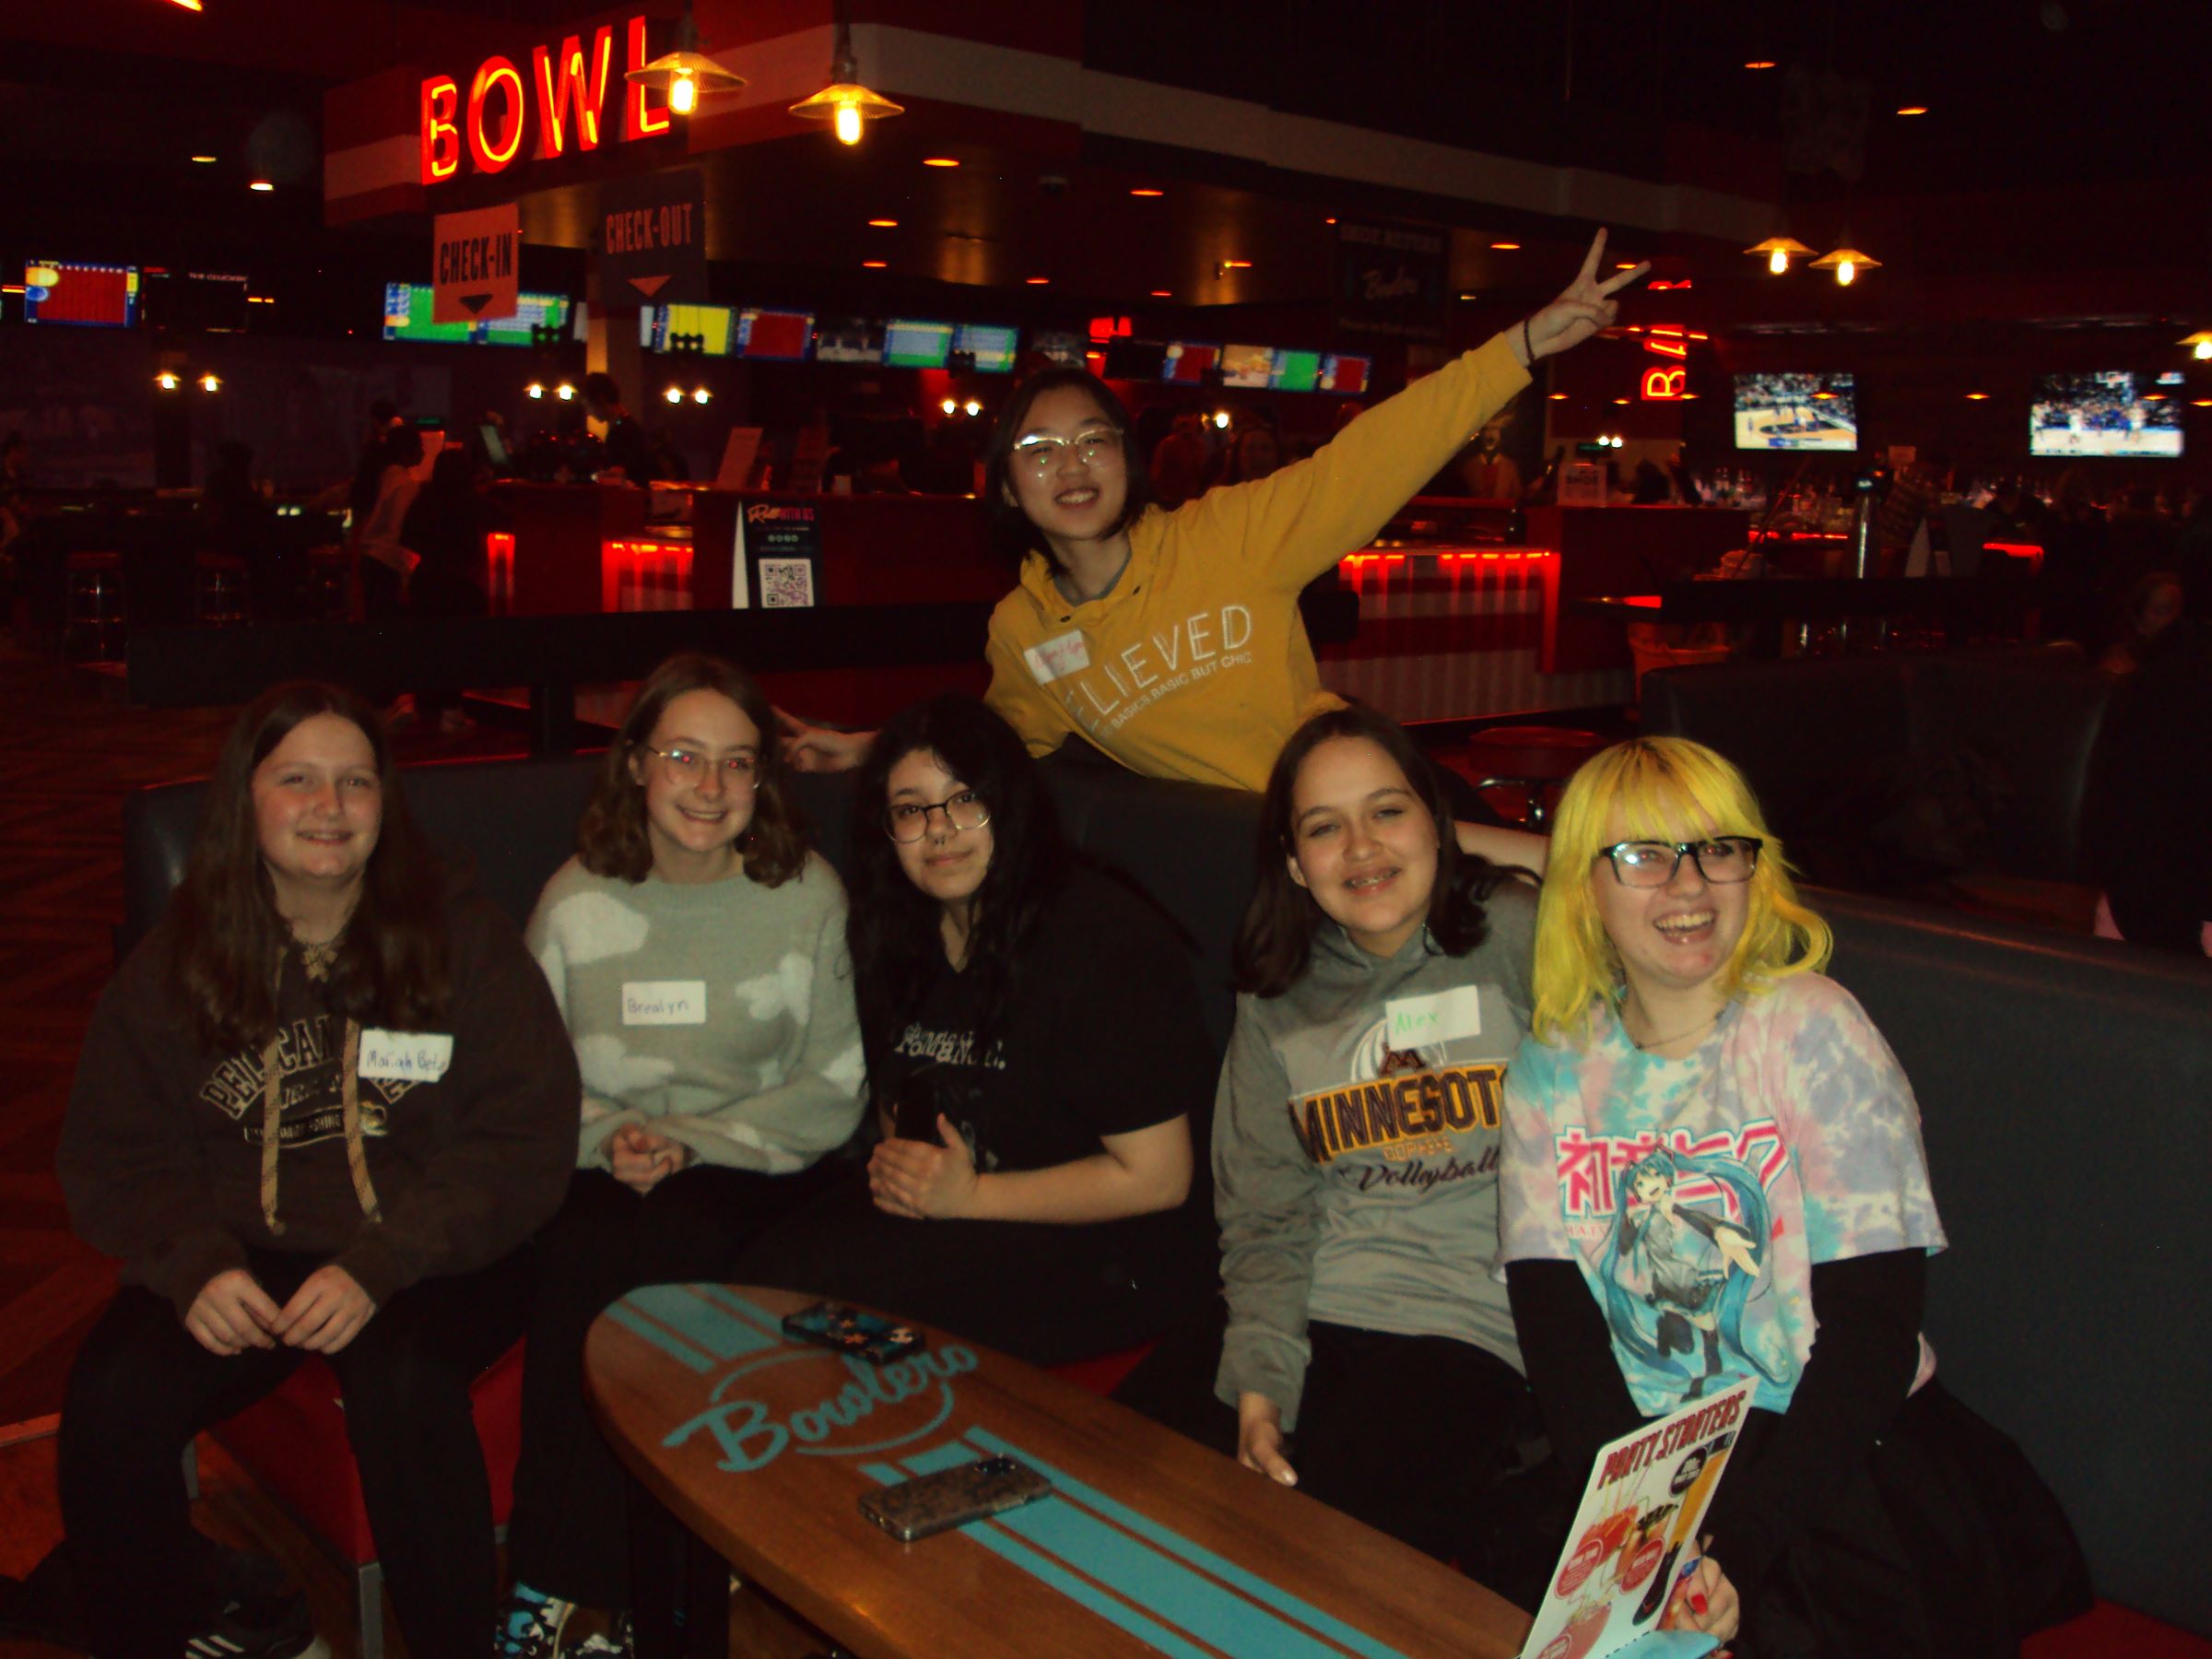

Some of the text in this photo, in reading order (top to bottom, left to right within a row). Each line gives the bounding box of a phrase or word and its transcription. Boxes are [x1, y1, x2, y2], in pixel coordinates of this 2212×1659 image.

[421, 15, 670, 185] BOWL
[440, 232, 513, 285] CHECK-IN
[605, 203, 693, 254] CHECK-OUT
[1065, 605, 1253, 730] LIEVED
[1110, 651, 1253, 730] BASICS BASIC BUT CHIC
[1288, 1067, 1506, 1164] MINNESOT
[659, 1343, 979, 1472] Bowlero
[1596, 1430, 1663, 1490] PARTY
[1654, 1390, 1747, 1461] STARTERS
